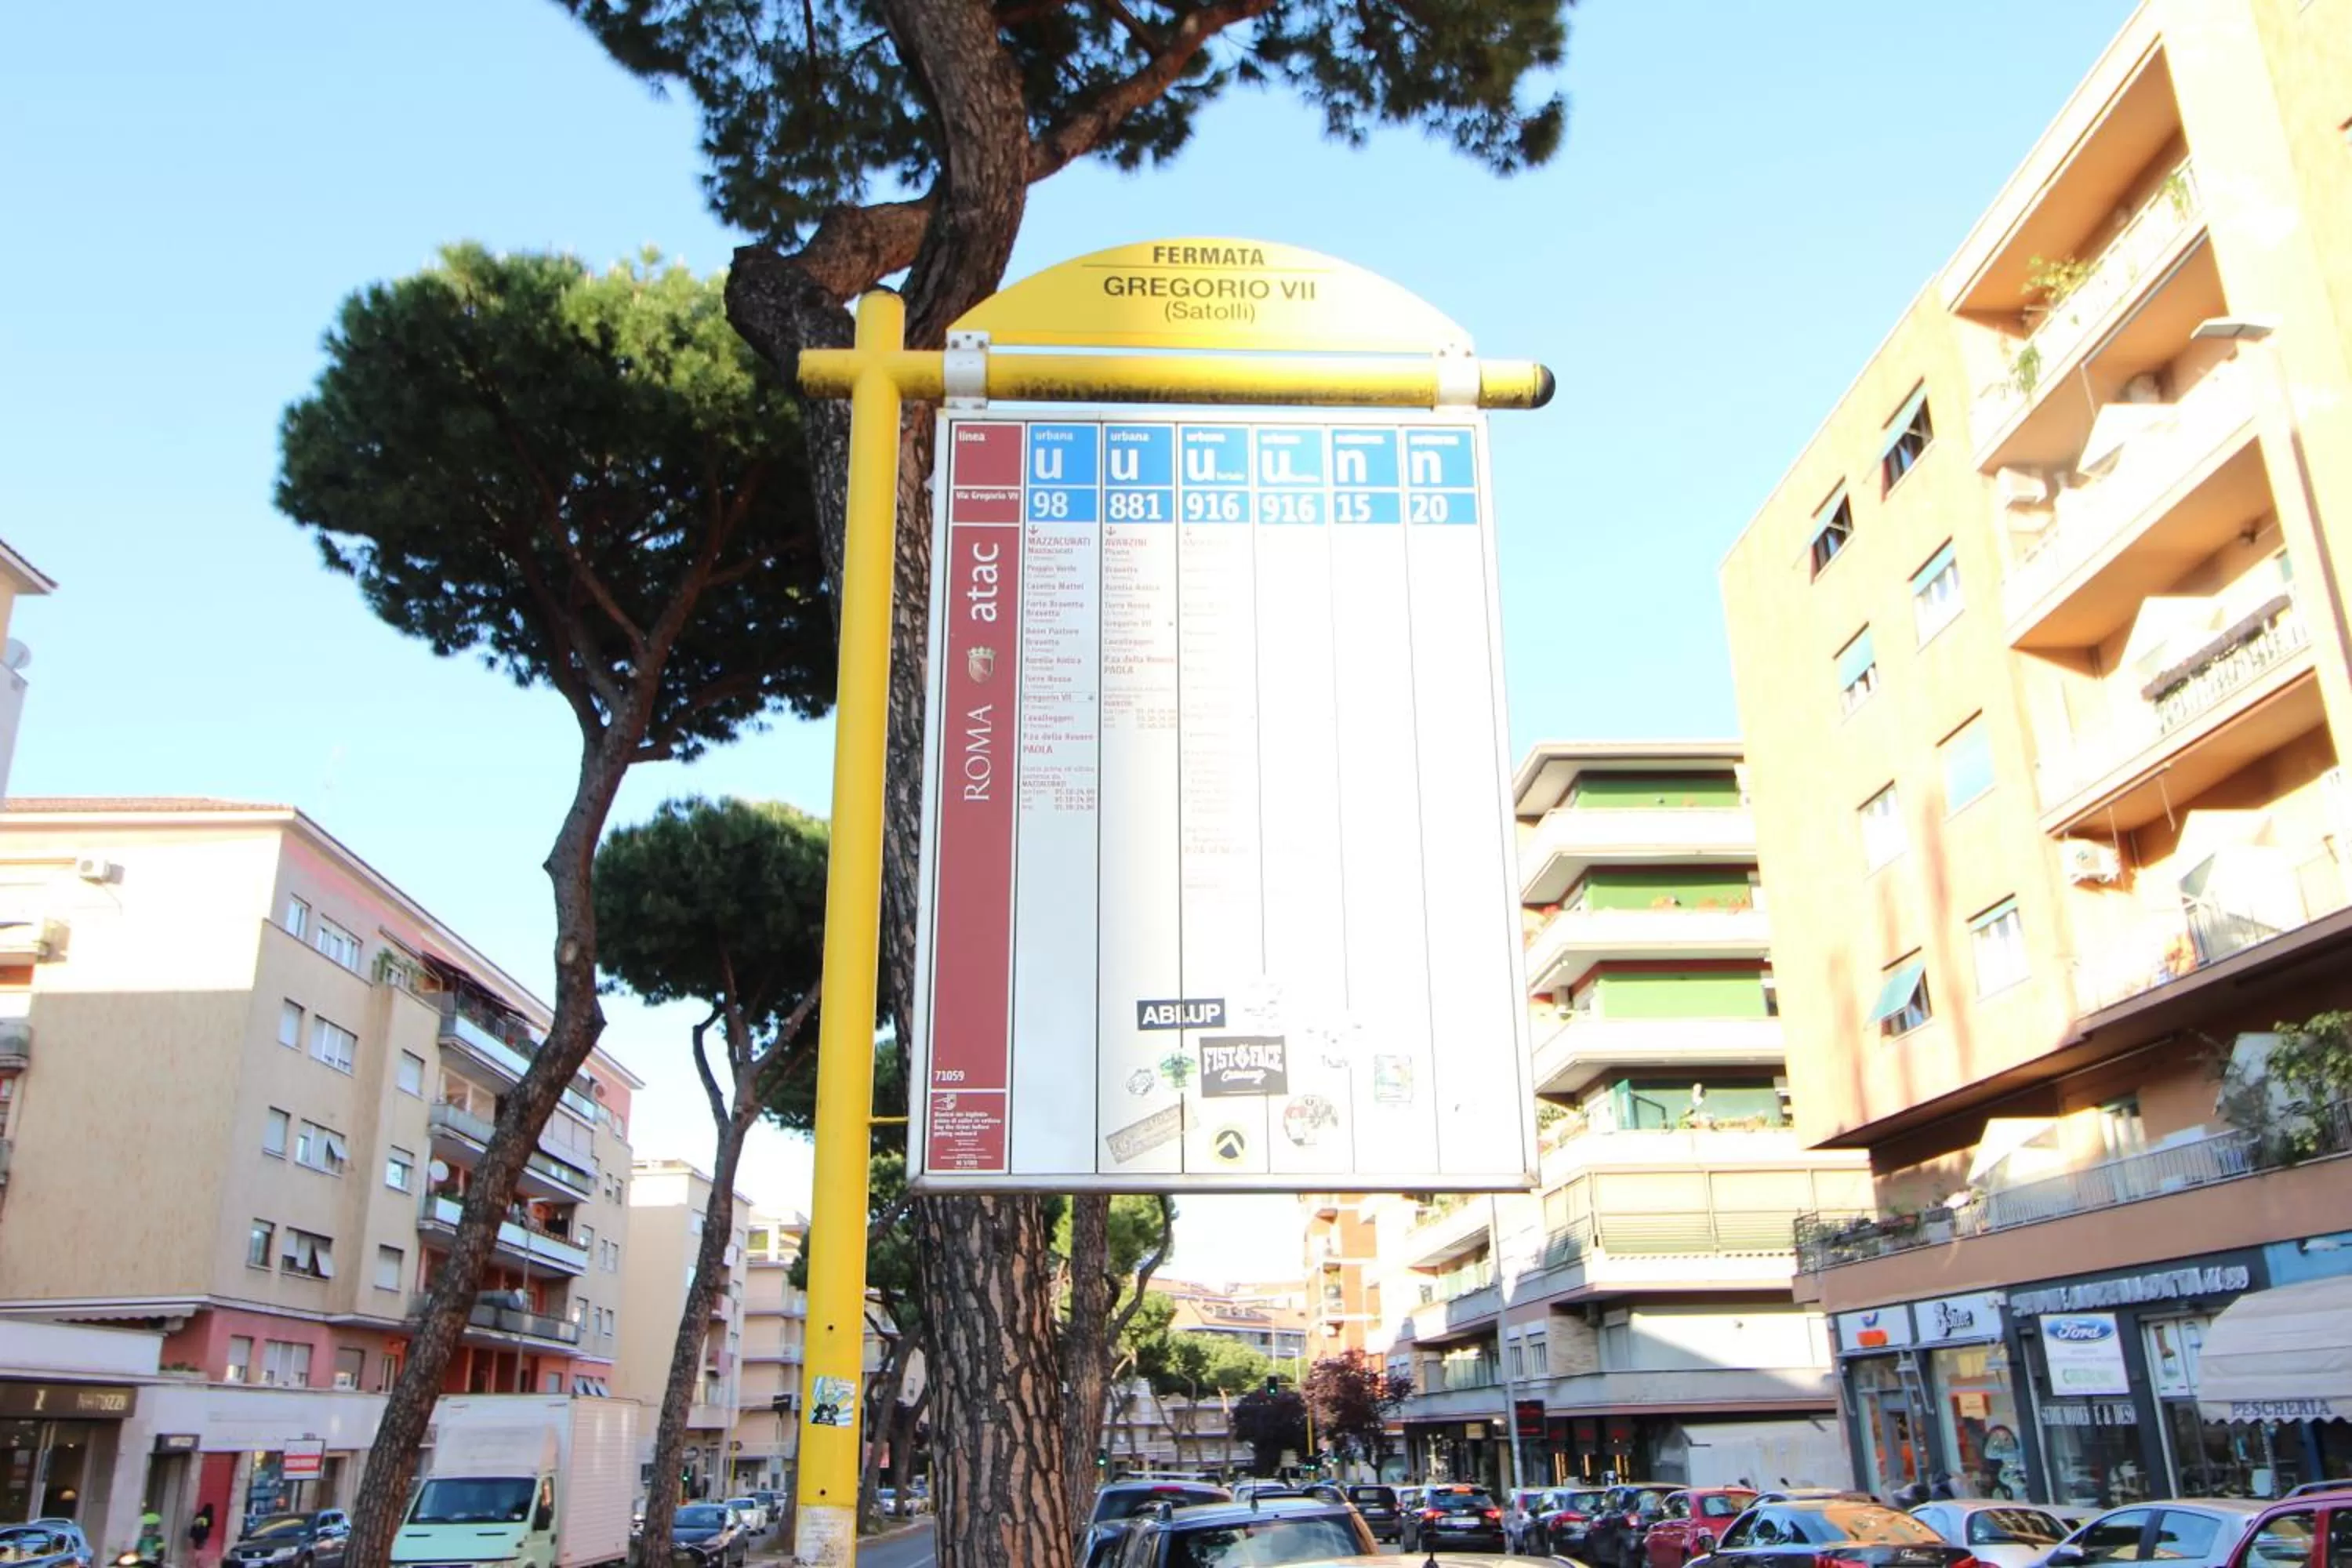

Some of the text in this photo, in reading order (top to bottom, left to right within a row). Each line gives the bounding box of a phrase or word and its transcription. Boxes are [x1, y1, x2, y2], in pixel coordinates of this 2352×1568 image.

[1152, 245, 1265, 265] FERMATA
[1103, 276, 1316, 299] GREGORIO VII
[1164, 301, 1256, 323] (Satolli)
[959, 431, 985, 441] linea
[1035, 431, 1073, 441] urbana
[1110, 431, 1149, 441] urbana
[1035, 447, 1062, 480] u
[1111, 448, 1139, 481] u
[1187, 448, 1215, 481] u
[1336, 448, 1367, 483] n
[1411, 449, 1443, 484] n
[971, 492, 1007, 501] Gregorio
[1034, 491, 1069, 519] 98
[1109, 492, 1162, 520] 881
[1186, 494, 1240, 521] 916
[1261, 495, 1316, 524] 916
[1338, 494, 1372, 523] 15
[1412, 495, 1449, 524] 20
[1028, 537, 1091, 546] MAZZACURATI
[967, 543, 999, 622] atac
[1103, 666, 1134, 674] PAOLA
[964, 705, 992, 801] ROMA
[935, 1070, 965, 1081] 71059
[2056, 1319, 2102, 1338] Ford
[2230, 1398, 2332, 1417] PESCHERIA
